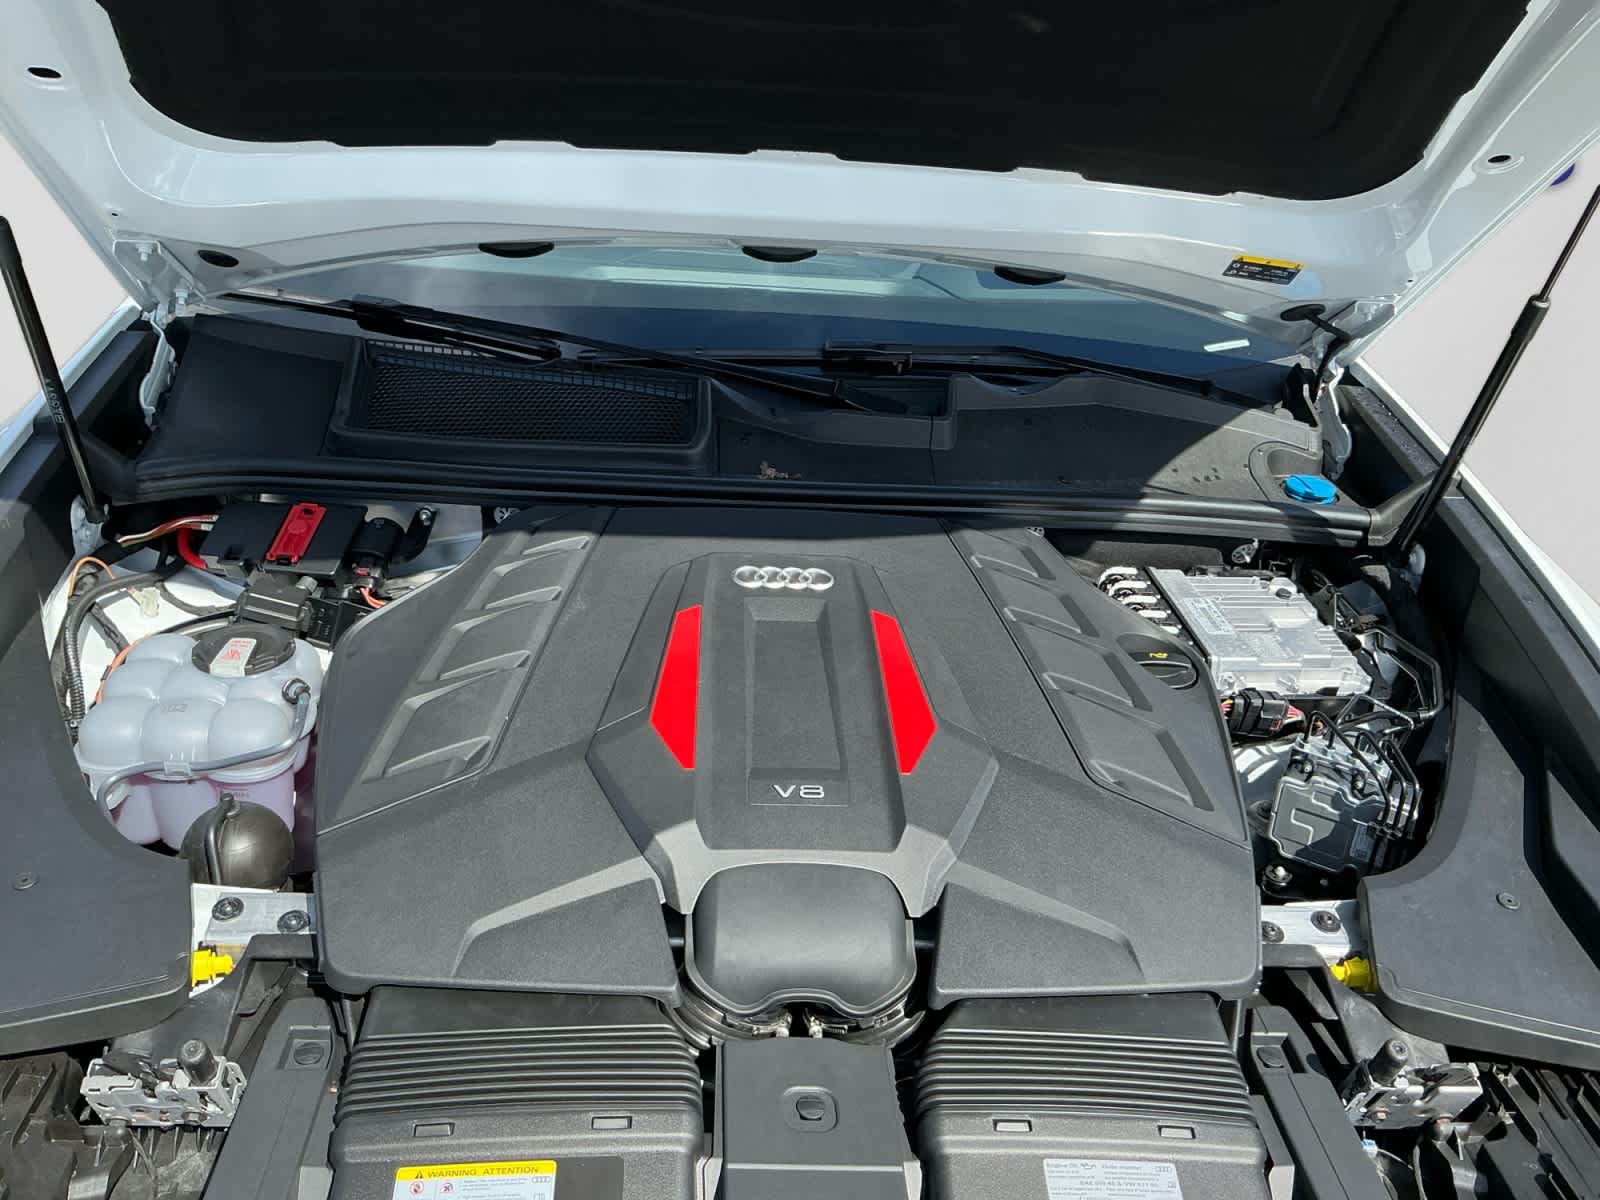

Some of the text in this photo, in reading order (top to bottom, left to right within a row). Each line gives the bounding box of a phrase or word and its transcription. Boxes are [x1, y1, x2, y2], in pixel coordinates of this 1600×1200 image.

[772, 784, 825, 799] V8
[427, 1166, 539, 1179] WARNING ATTENTION
